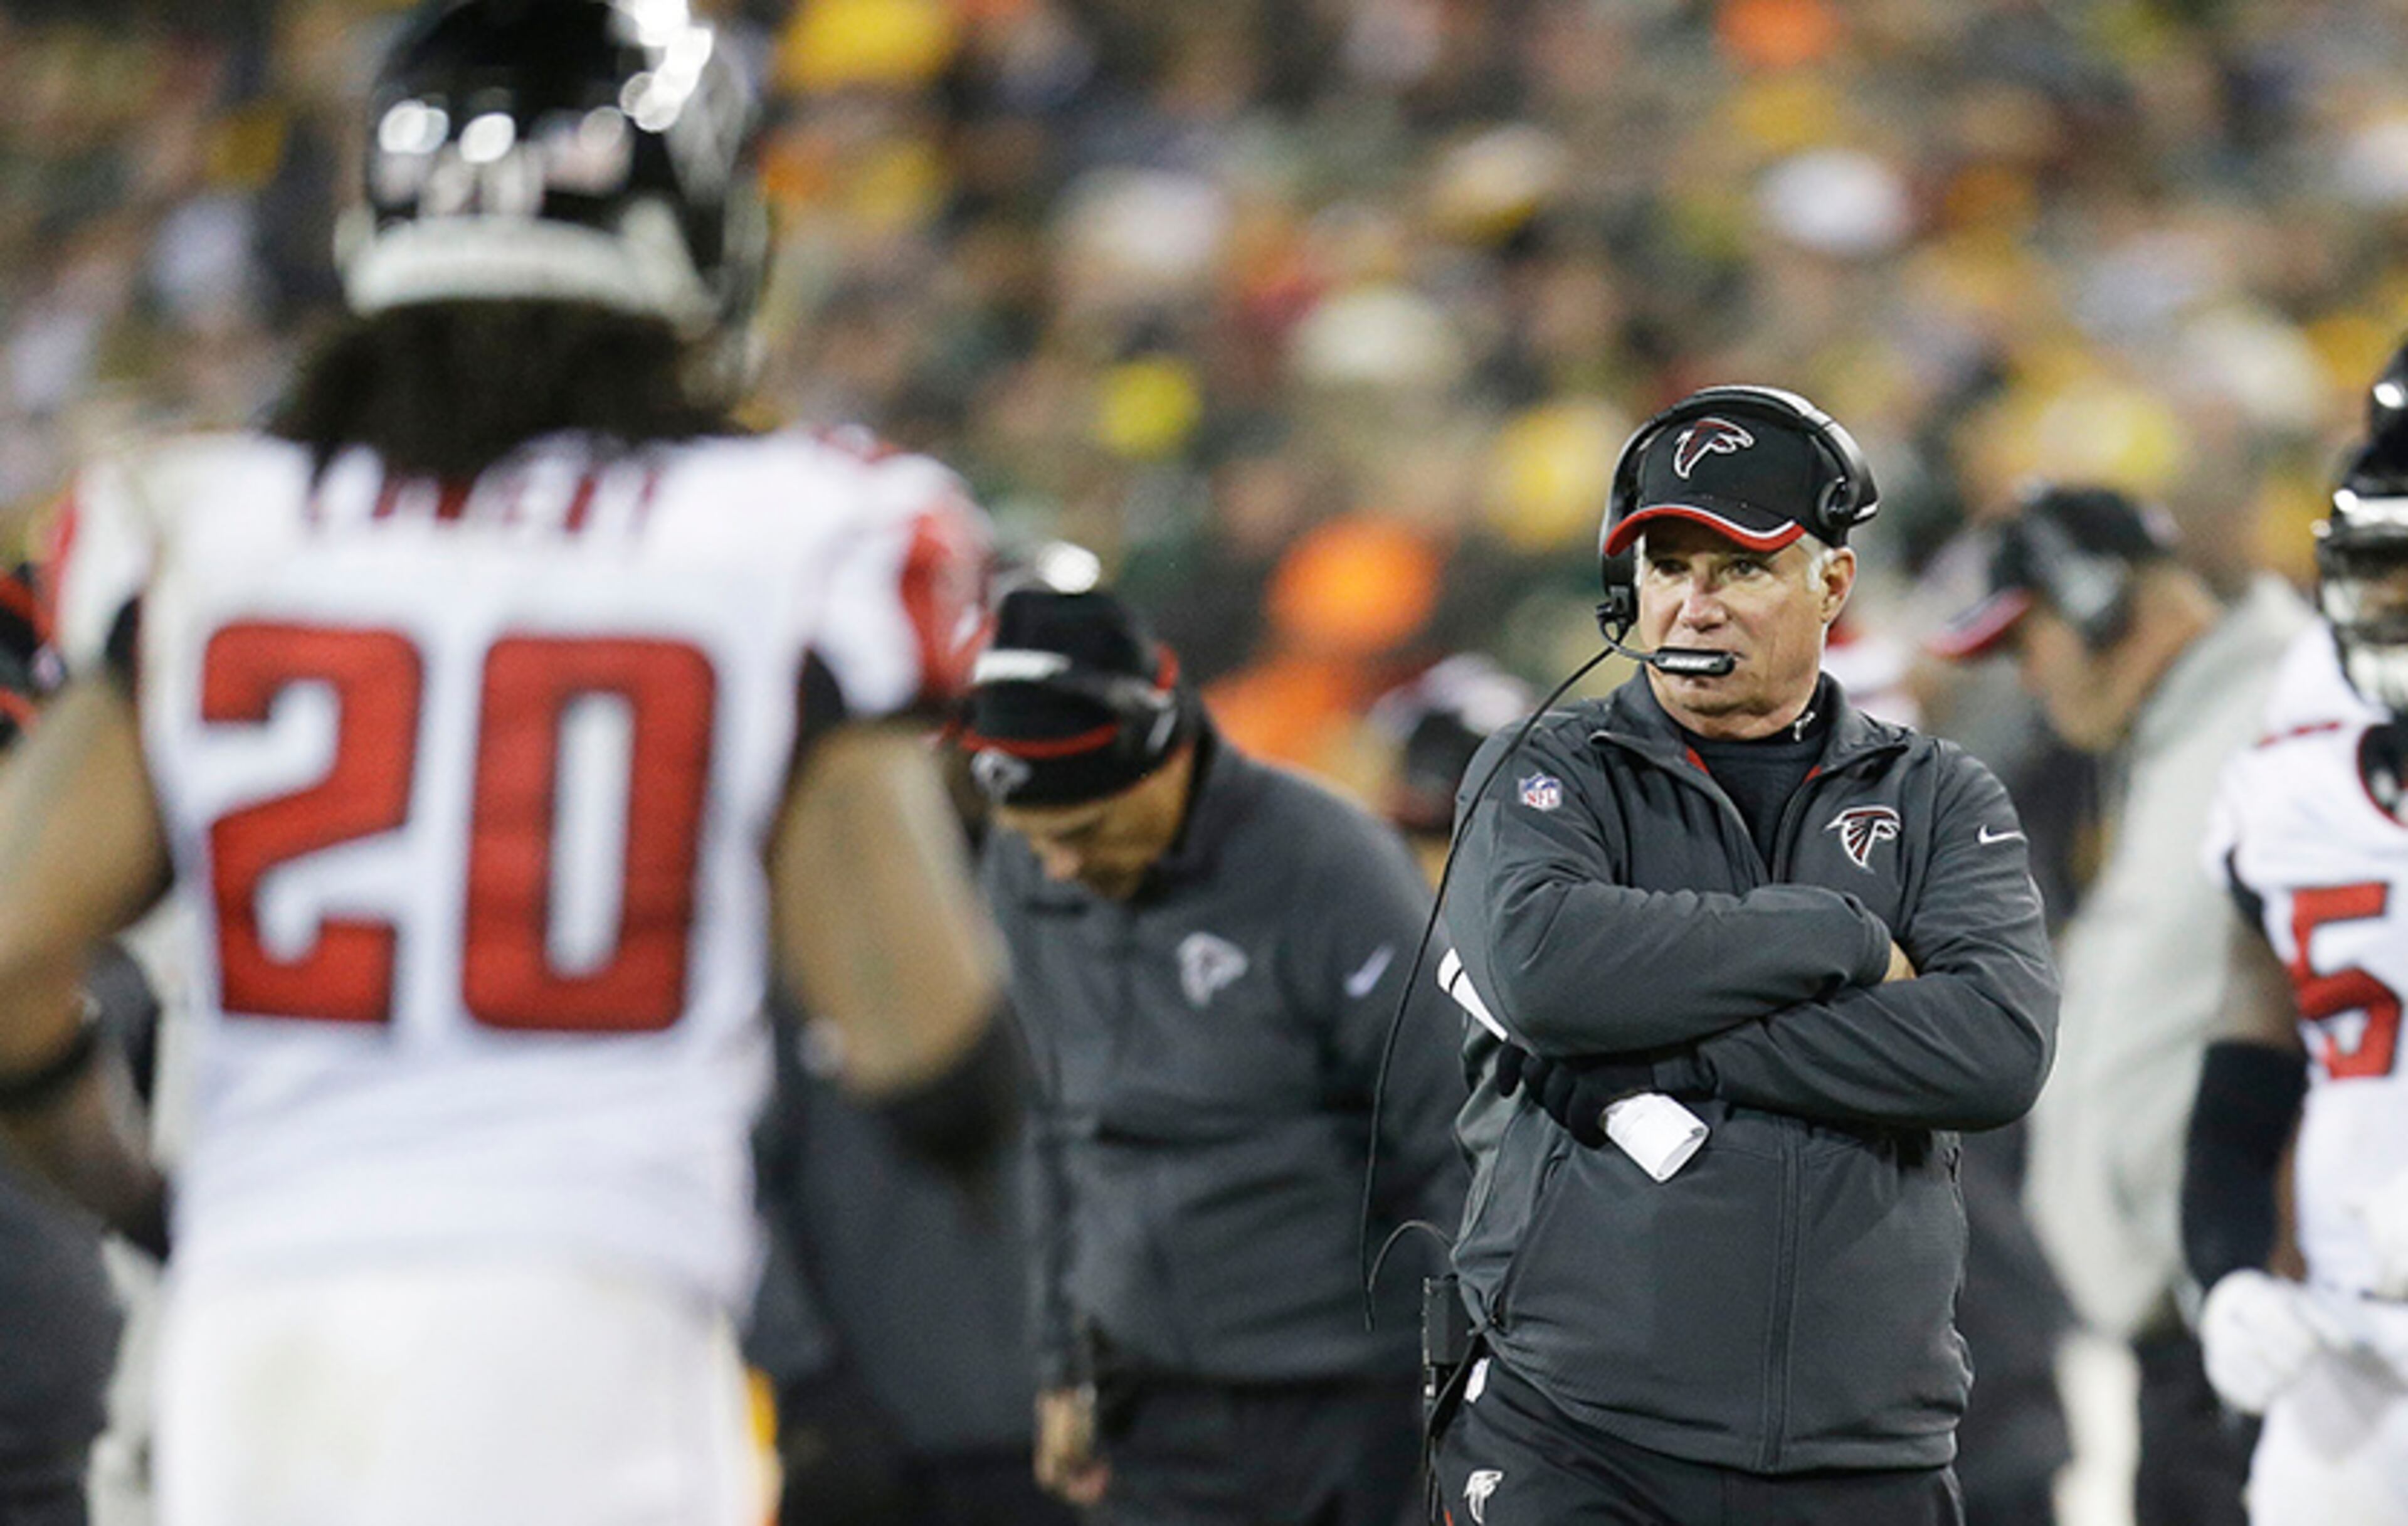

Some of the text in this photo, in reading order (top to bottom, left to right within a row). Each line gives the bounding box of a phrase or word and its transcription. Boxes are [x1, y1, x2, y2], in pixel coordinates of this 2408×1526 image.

[201, 619, 716, 1032] 20
[1526, 788, 1555, 807] NFL
[2289, 881, 2402, 1079] 5
